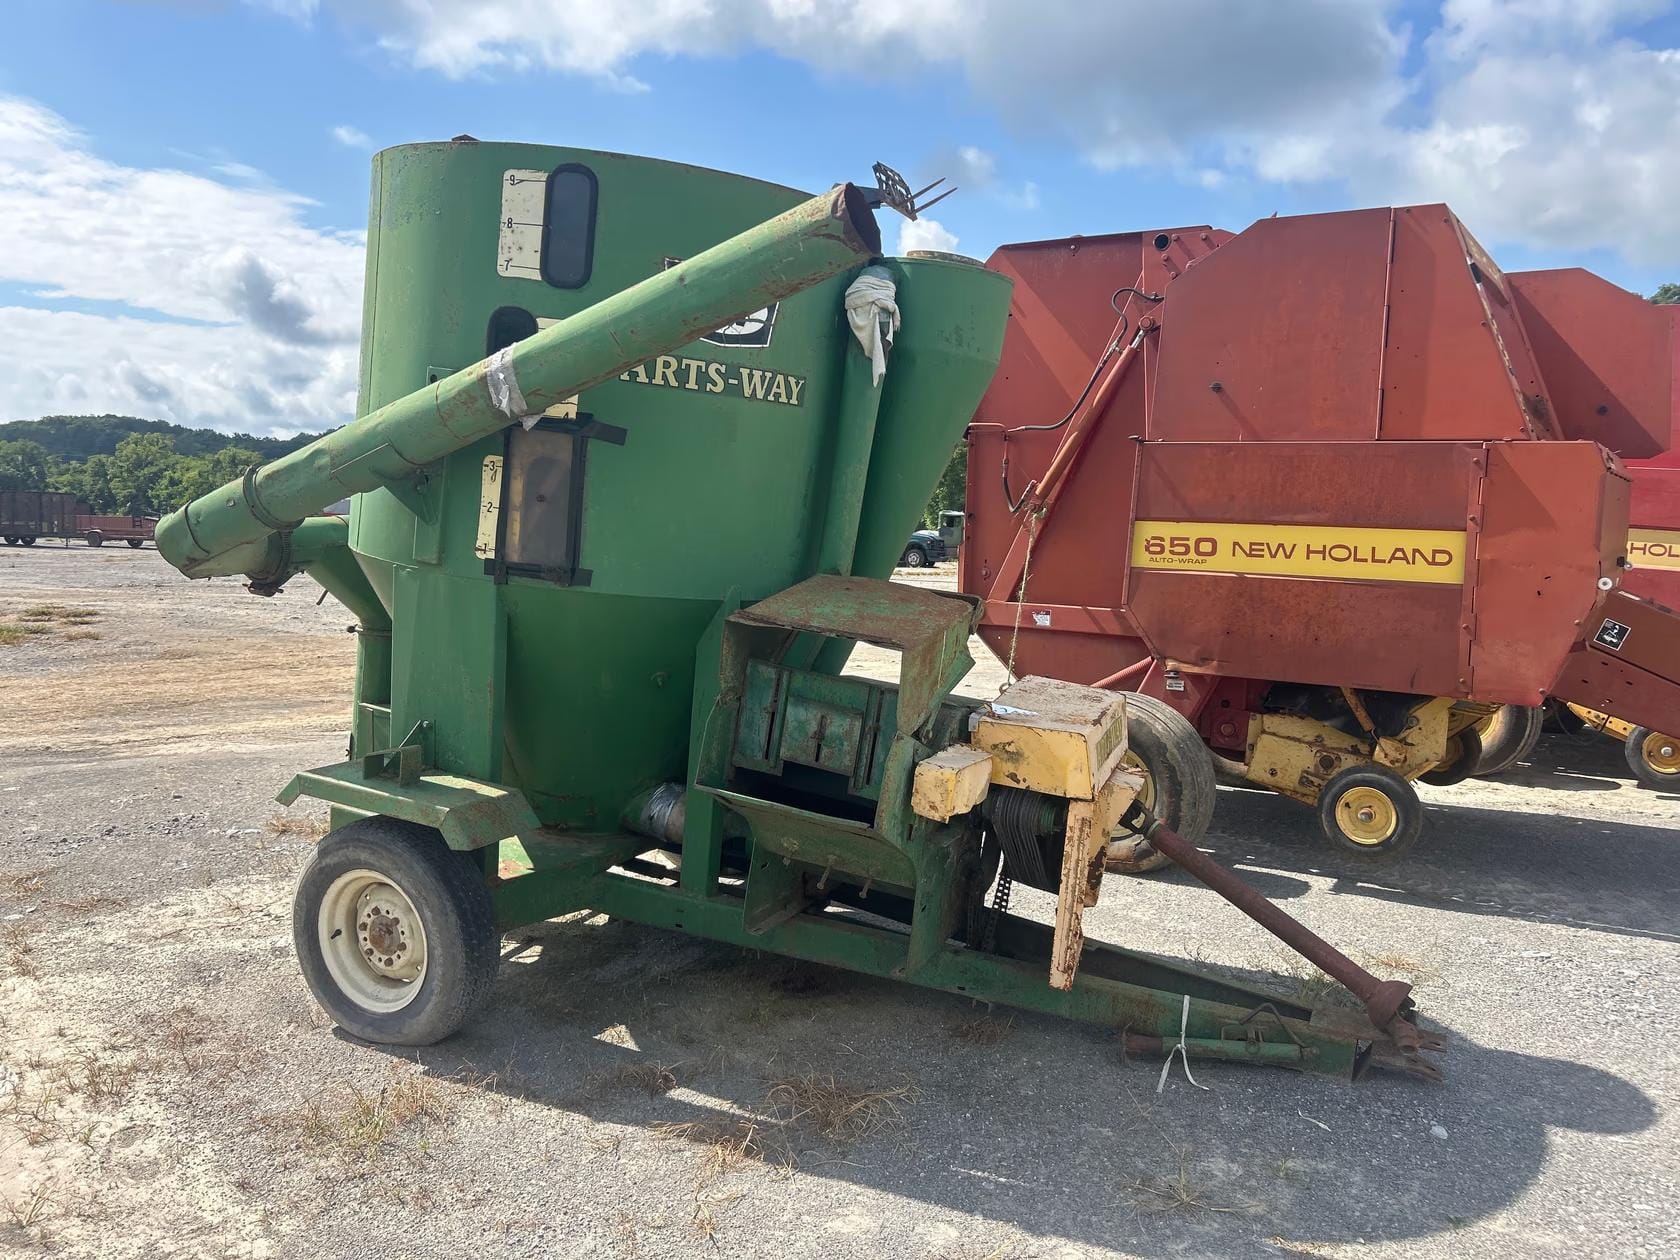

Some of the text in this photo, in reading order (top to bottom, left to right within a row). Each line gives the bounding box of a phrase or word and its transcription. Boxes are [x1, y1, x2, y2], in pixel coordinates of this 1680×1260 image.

[509, 174, 516, 186] 9
[507, 217, 513, 229] 8
[504, 259, 510, 271] 7
[489, 460, 495, 471] 3
[487, 501, 493, 513] 2
[1144, 535, 1453, 567] 650 NEW HOLLAND
[1148, 556, 1207, 565] AUTO-WRAP
